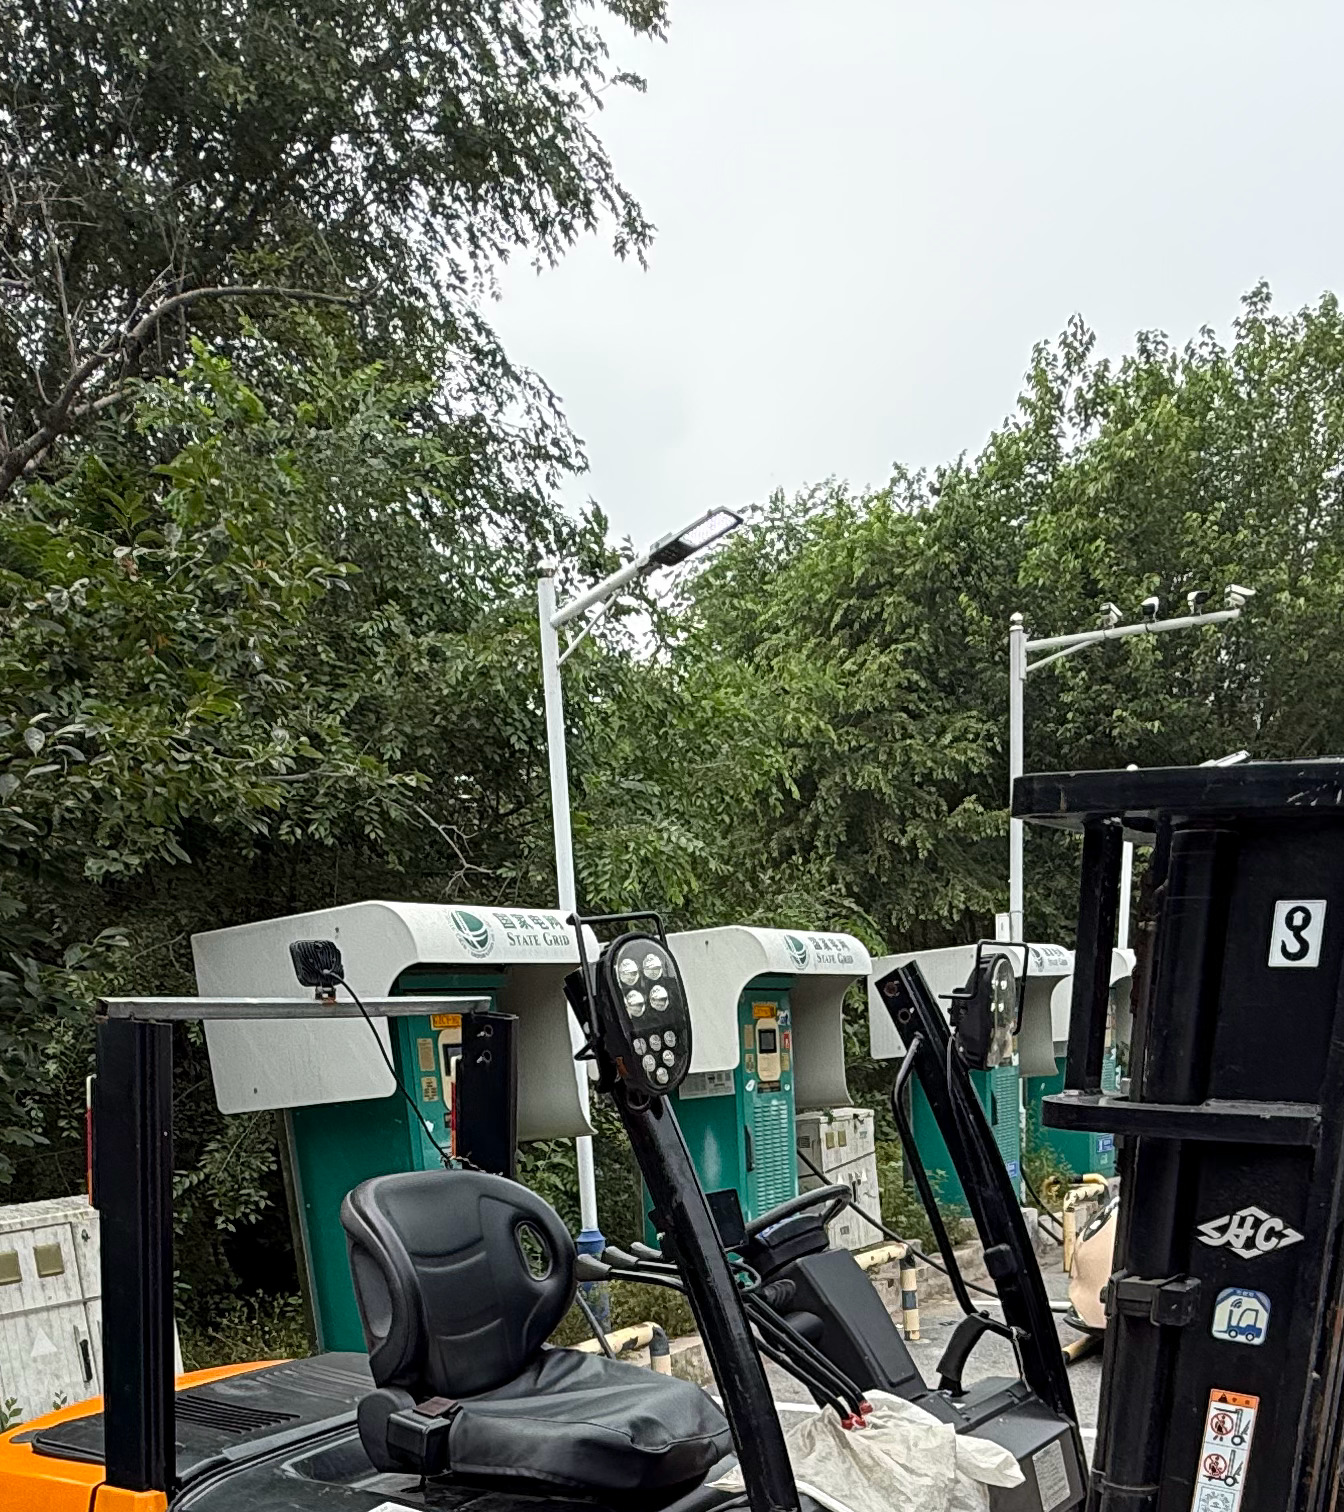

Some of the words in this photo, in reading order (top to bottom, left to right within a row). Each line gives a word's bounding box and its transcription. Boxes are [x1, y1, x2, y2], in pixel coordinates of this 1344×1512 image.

[492, 912, 564, 931] 国家电网
[506, 931, 541, 946] STATE
[542, 931, 570, 946] GRID
